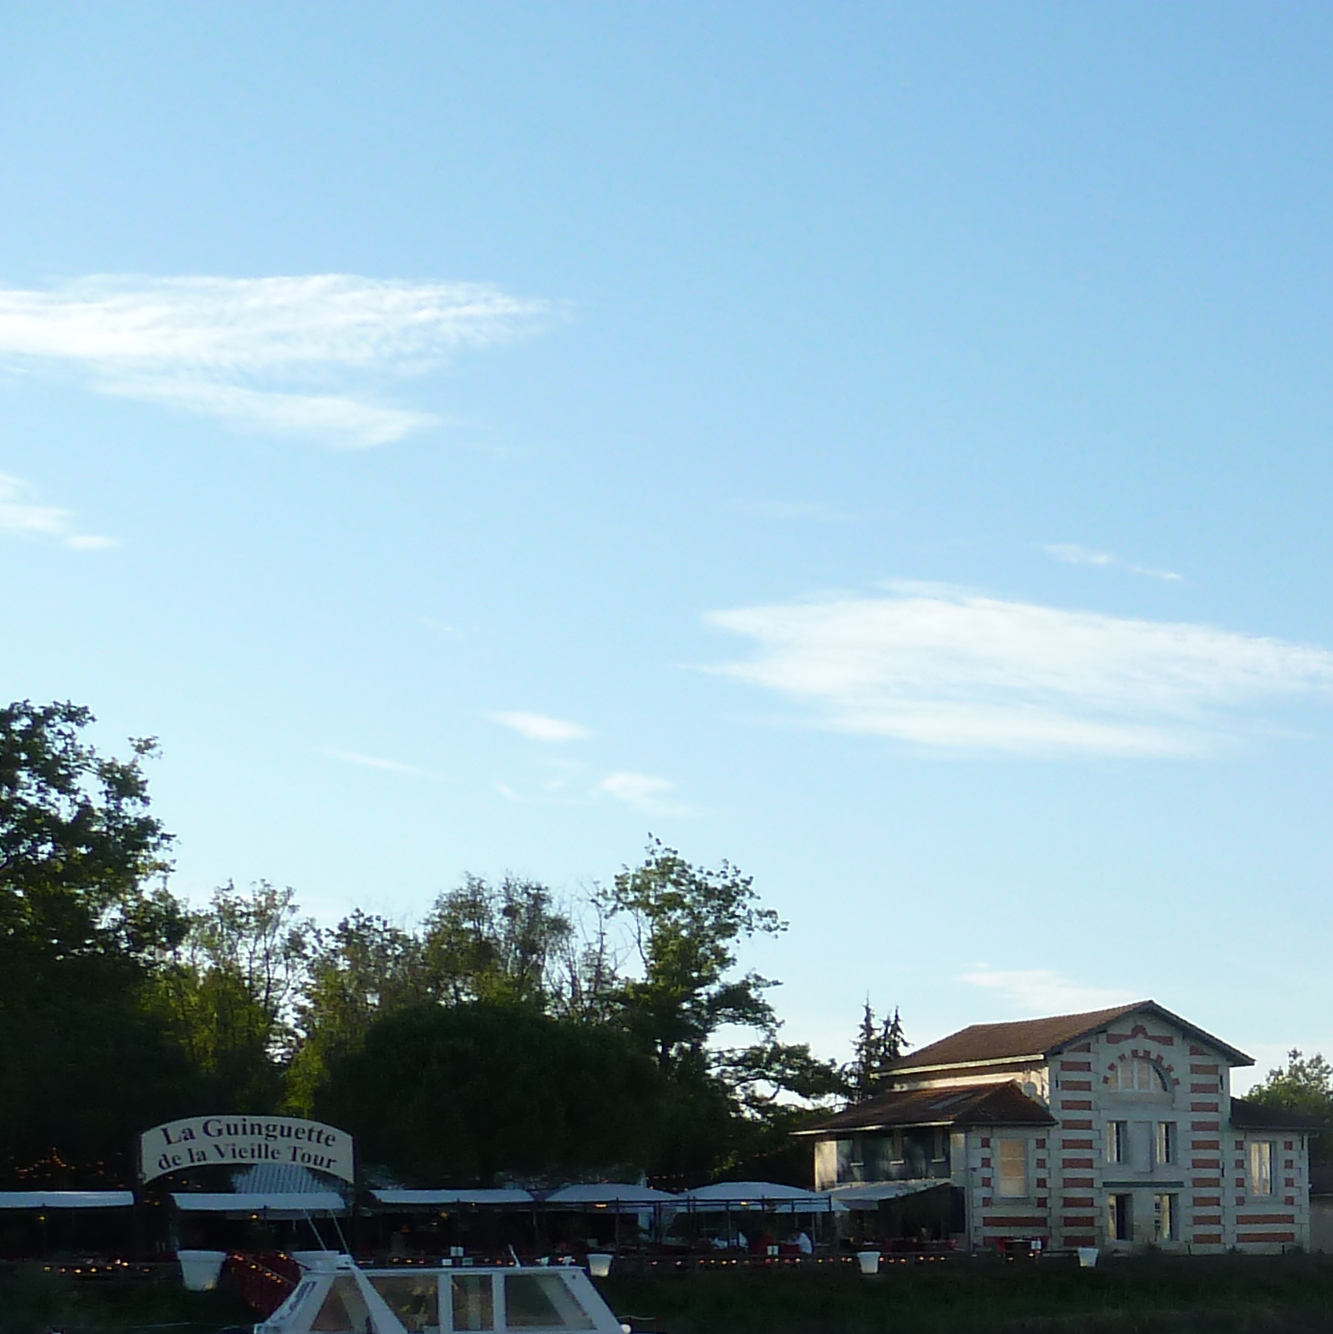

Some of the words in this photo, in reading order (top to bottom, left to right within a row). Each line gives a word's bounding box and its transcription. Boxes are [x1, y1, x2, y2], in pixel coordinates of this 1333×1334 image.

[160, 1126, 196, 1145] La
[202, 1118, 336, 1147] Guinguette
[158, 1154, 182, 1170] de
[187, 1148, 207, 1163] la
[213, 1143, 281, 1159] Vieille
[288, 1146, 337, 1169] Tour
